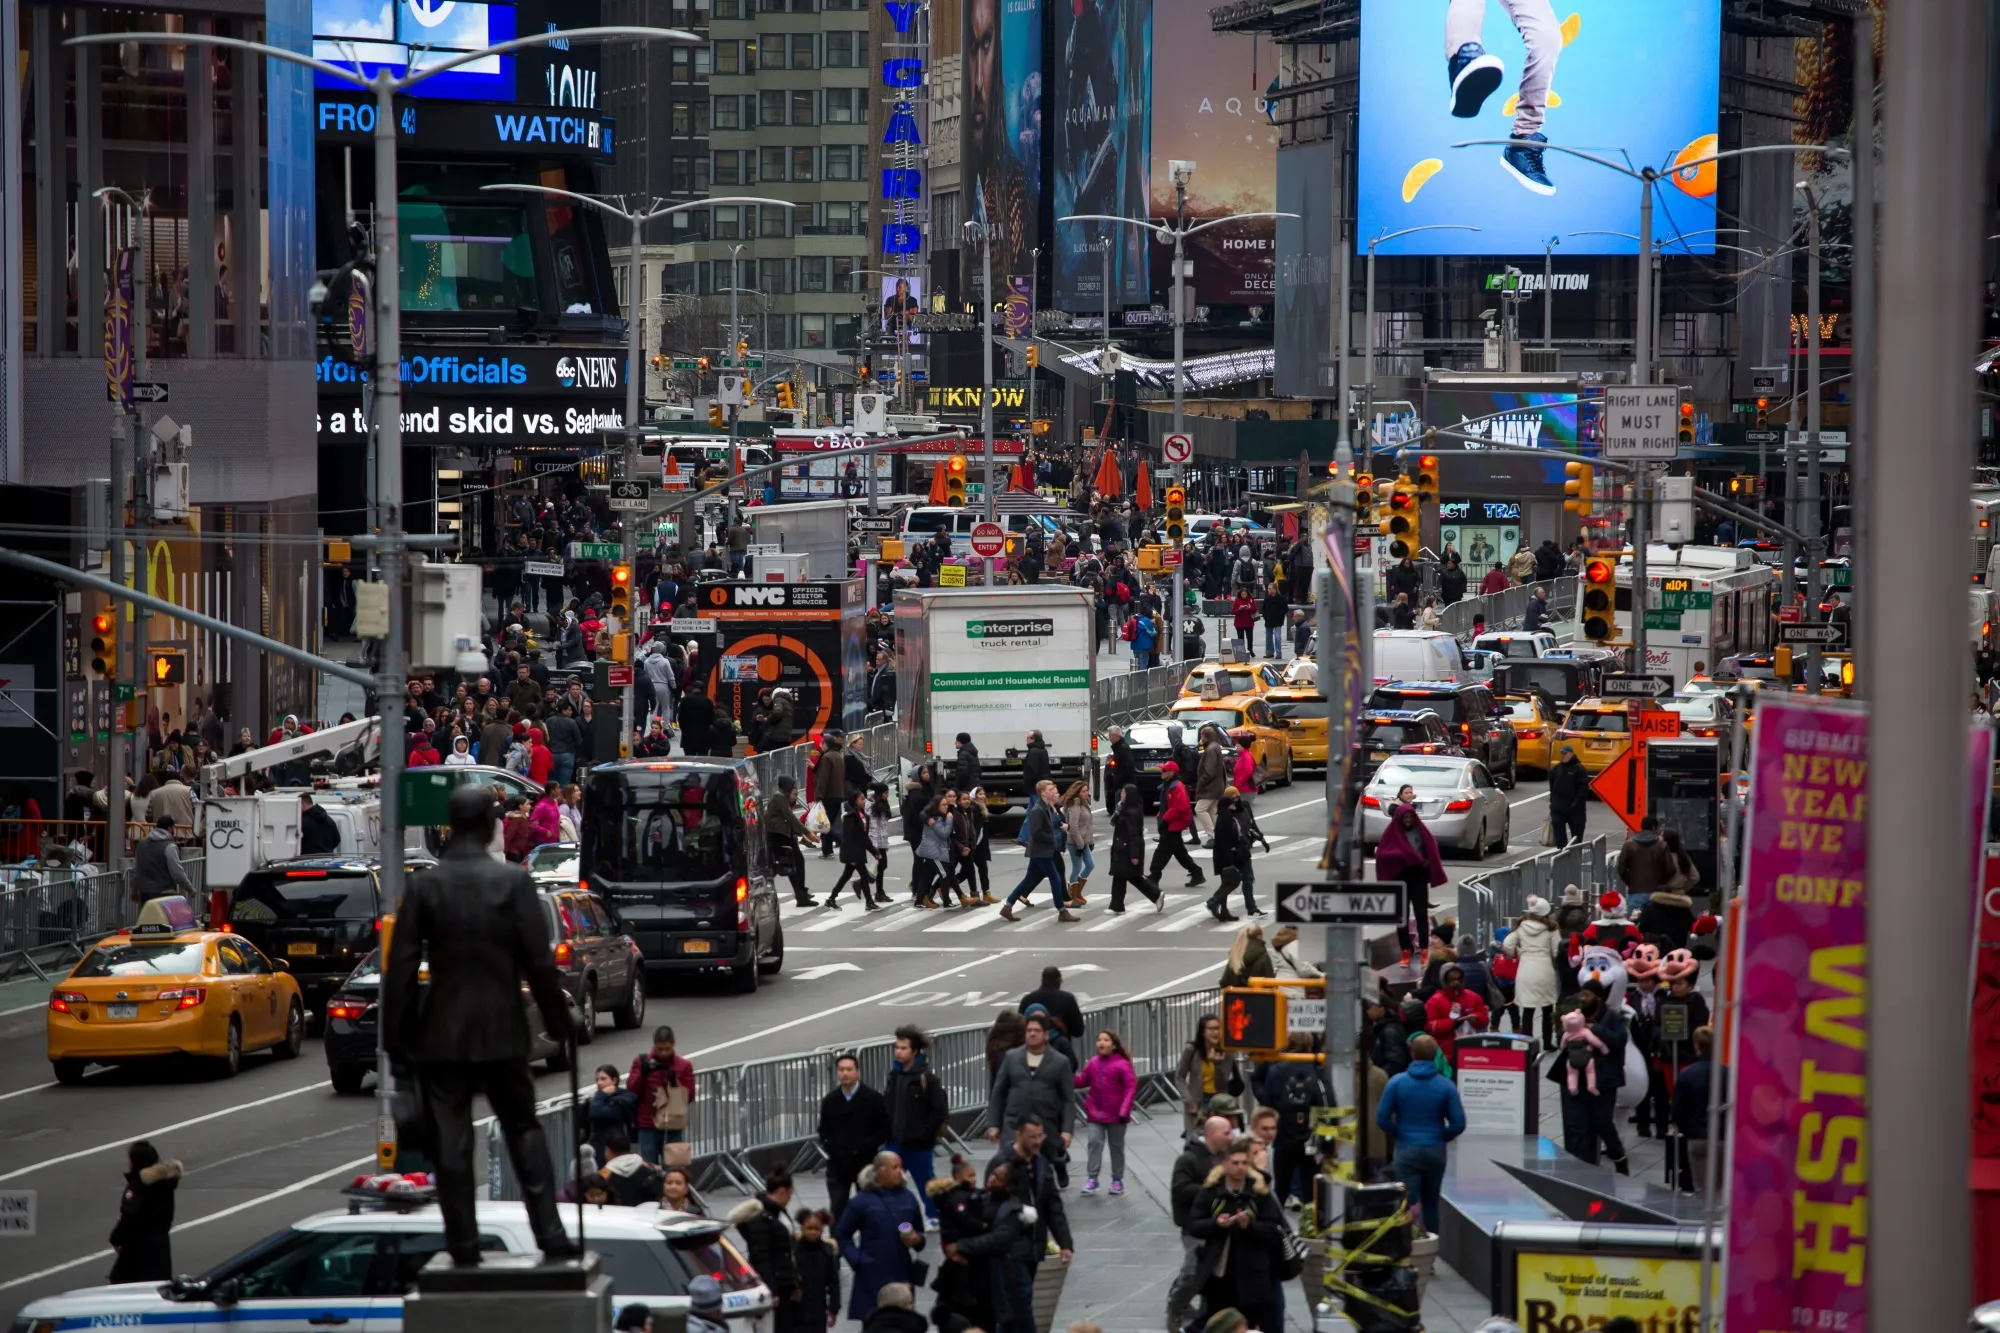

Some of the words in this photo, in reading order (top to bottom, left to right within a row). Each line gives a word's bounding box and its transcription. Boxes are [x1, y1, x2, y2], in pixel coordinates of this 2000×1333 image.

[1198, 97, 1268, 116] AQU
[1065, 107, 1116, 123] AQUAMAN
[495, 114, 585, 144] WATCH
[962, 222, 1004, 242] AQUAAN
[1073, 243, 1087, 254] BLACK
[1088, 243, 1105, 253] MANTA
[1223, 239, 1266, 249] HOME
[1077, 282, 1096, 291] DECEMBER
[1244, 281, 1275, 289] DECE
[1519, 273, 1590, 290] TRADITION
[1127, 313, 1169, 322] OUTFRT
[413, 355, 527, 384] Officials
[556, 365, 576, 378] abc
[576, 357, 617, 388] NEWS
[140, 387, 161, 397] WAY
[1608, 396, 1640, 407] RIGHT
[1646, 396, 1675, 407] LANE
[330, 412, 346, 433] a
[449, 406, 513, 434] skid
[523, 414, 559, 434] vs.
[565, 407, 622, 435] Seahawks
[1621, 415, 1661, 429] MUST
[1491, 420, 1542, 449] NAVY
[814, 436, 824, 449] C
[830, 436, 865, 449] BAO
[1608, 437, 1636, 448] TURN
[1642, 437, 1676, 449] RIGHT
[535, 462, 575, 472] CITIZEN
[965, 485, 975, 493] 44
[1484, 503, 1520, 518] TRA
[653, 513, 678, 523] ATM
[658, 522, 674, 530] ATM
[654, 528, 678, 538] Drink
[584, 545, 593, 555] W
[597, 545, 610, 555] 45
[941, 575, 964, 585] CLOSING
[1837, 571, 1846, 583] W
[1666, 580, 1688, 590] M104
[735, 587, 785, 605] NYC
[1665, 593, 1675, 607] W
[1681, 593, 1696, 607] 45
[1702, 592, 1710, 603] St
[968, 620, 1052, 636] enterprise
[1790, 629, 1808, 638] ONE
[1817, 629, 1837, 638] WAY
[980, 639, 1007, 647] truck
[1011, 638, 1041, 647] rental
[933, 677, 985, 687] Commercial
[987, 677, 1003, 686] and
[1005, 676, 1051, 686] Household
[1053, 675, 1086, 685] Rentals
[1611, 681, 1632, 691] ONE
[1642, 681, 1664, 691] WAY
[118, 686, 125, 698] 7
[933, 702, 1012, 711] enterprisetrucks.com
[1634, 719, 1676, 733] RAISE
[1784, 728, 1868, 753] SUBMI
[1782, 753, 1868, 787] NEW
[214, 819, 240, 828] VERSALIFT
[1779, 820, 1844, 854] EVE
[1295, 894, 1331, 912] ONE
[1348, 894, 1388, 912] WAY
[1792, 943, 1868, 1287] WISH
[1544, 1272, 1567, 1283] Your
[1569, 1273, 1592, 1284] kind
[1595, 1274, 1607, 1284] of
[1609, 1275, 1642, 1286] music.
[1558, 1285, 1581, 1297] Your
[1584, 1286, 1607, 1298] kind
[1610, 1287, 1621, 1298] of
[1623, 1288, 1666, 1300] musical.
[91, 1313, 142, 1328] POLICE
[1818, 1309, 1848, 1331] BE
